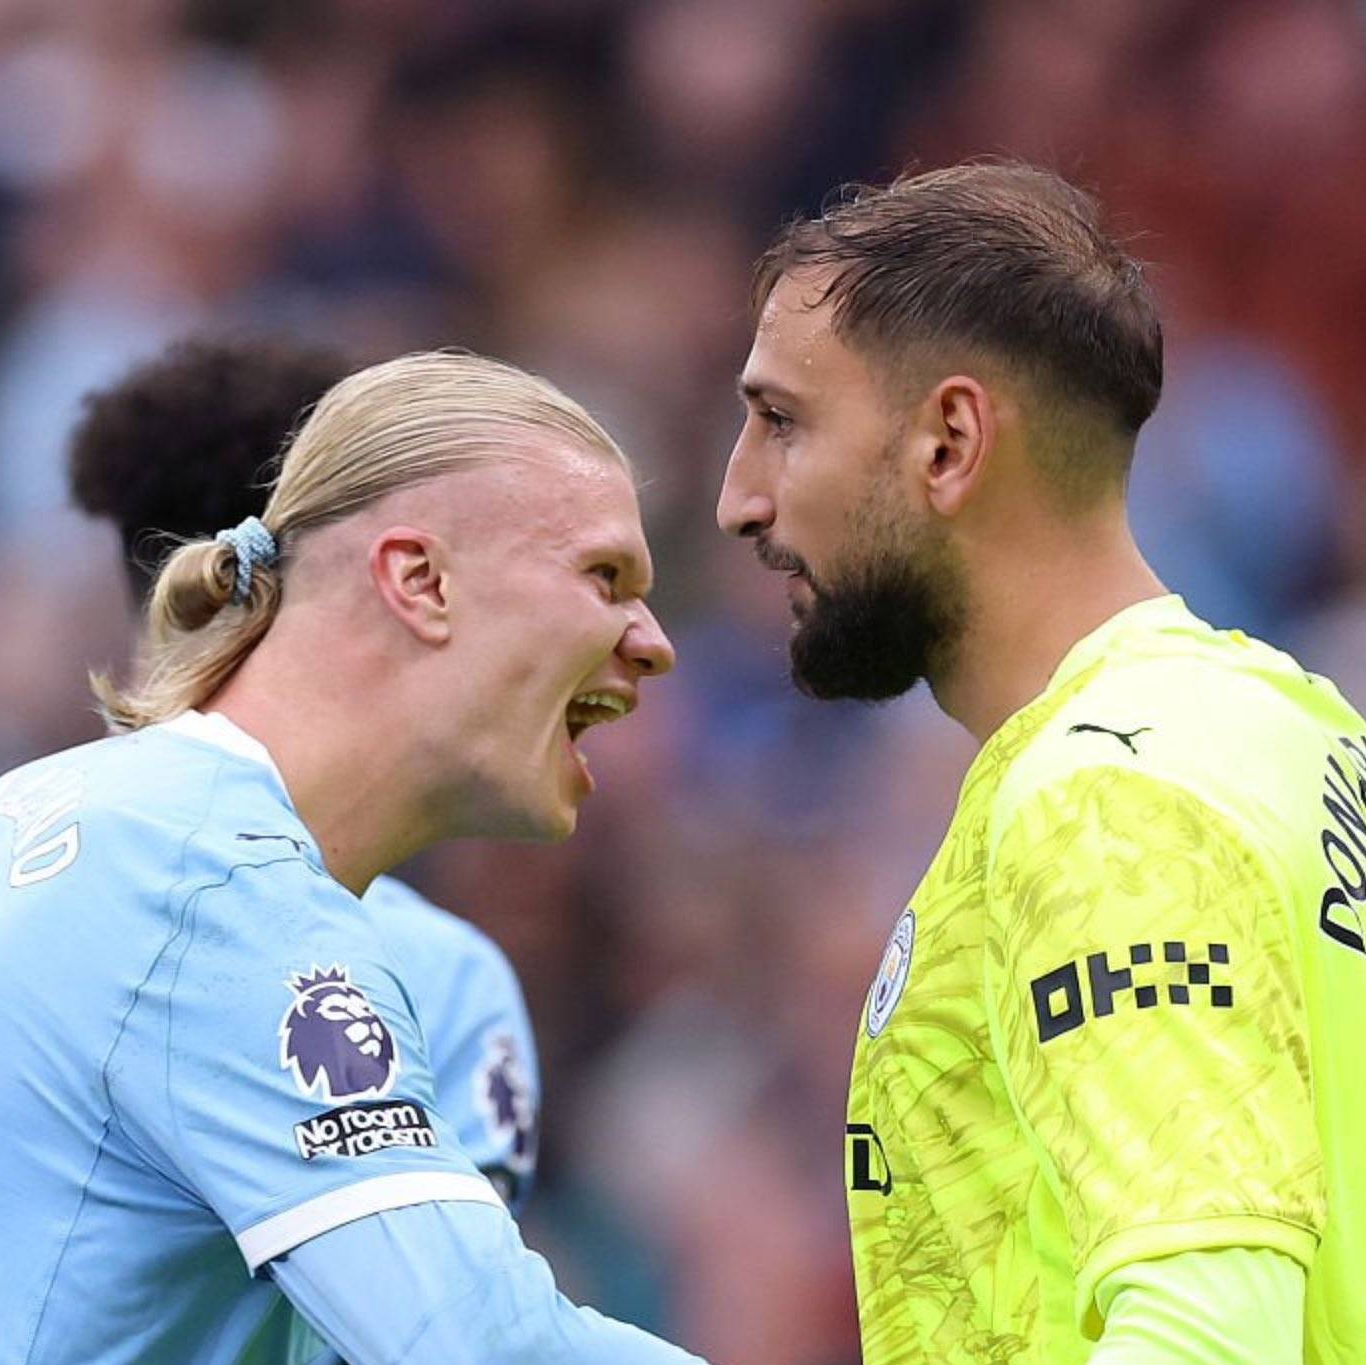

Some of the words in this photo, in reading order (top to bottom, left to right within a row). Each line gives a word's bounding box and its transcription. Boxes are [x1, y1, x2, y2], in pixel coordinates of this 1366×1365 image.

[1030, 941, 1234, 1045] OKX
[294, 1118, 340, 1148] No
[339, 1105, 420, 1135] room
[345, 1127, 437, 1157] racism
